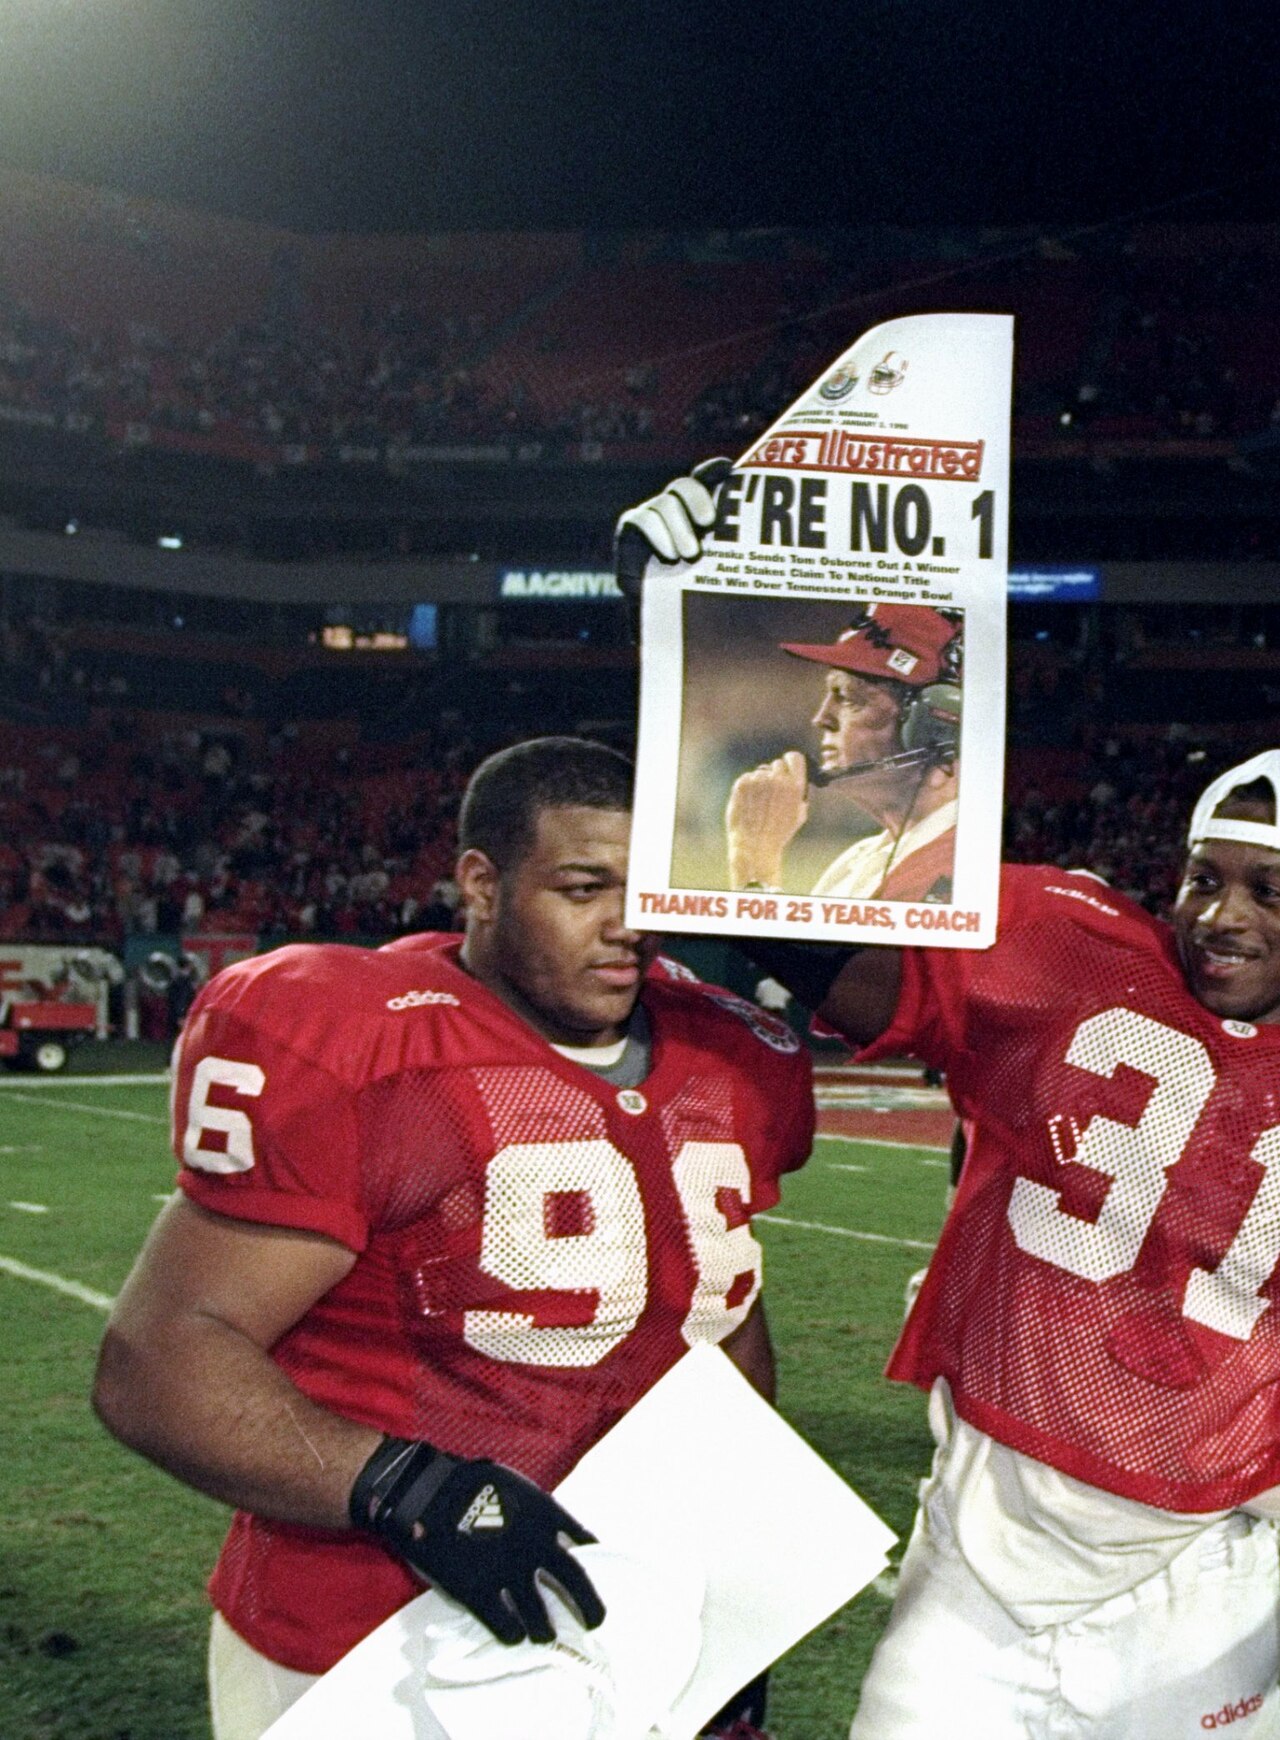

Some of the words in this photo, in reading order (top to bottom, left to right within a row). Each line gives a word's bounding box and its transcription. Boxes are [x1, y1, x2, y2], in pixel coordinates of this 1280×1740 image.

[817, 430, 986, 477] Illustrated
[713, 473, 829, 549] E'RE
[850, 481, 947, 557] NO.
[970, 489, 996, 560] 1
[716, 562, 740, 574] And
[744, 564, 785, 577] Stakes
[789, 567, 825, 579] Claim
[828, 570, 843, 581] To
[847, 571, 899, 585] National
[903, 575, 931, 587] Title
[748, 550, 785, 563] Sends
[789, 553, 816, 565] Tom
[819, 556, 872, 569] Osborne
[876, 559, 899, 571] Out
[903, 561, 912, 571] A
[916, 562, 960, 574] Winner
[694, 574, 722, 586] With
[725, 577, 749, 588] Win
[753, 579, 783, 590] Over
[786, 581, 851, 594] Tennessee
[855, 585, 868, 596] In
[872, 586, 917, 600] Orange
[921, 590, 953, 601] Bowl
[638, 892, 729, 919] THANKS
[735, 897, 779, 921] FOR
[786, 900, 814, 923] 25
[820, 902, 897, 930] YEARS,
[904, 907, 982, 933] COACH
[184, 1056, 266, 1176] 6
[463, 1139, 764, 1368] 96
[1201, 1692, 1265, 1730] adidas
